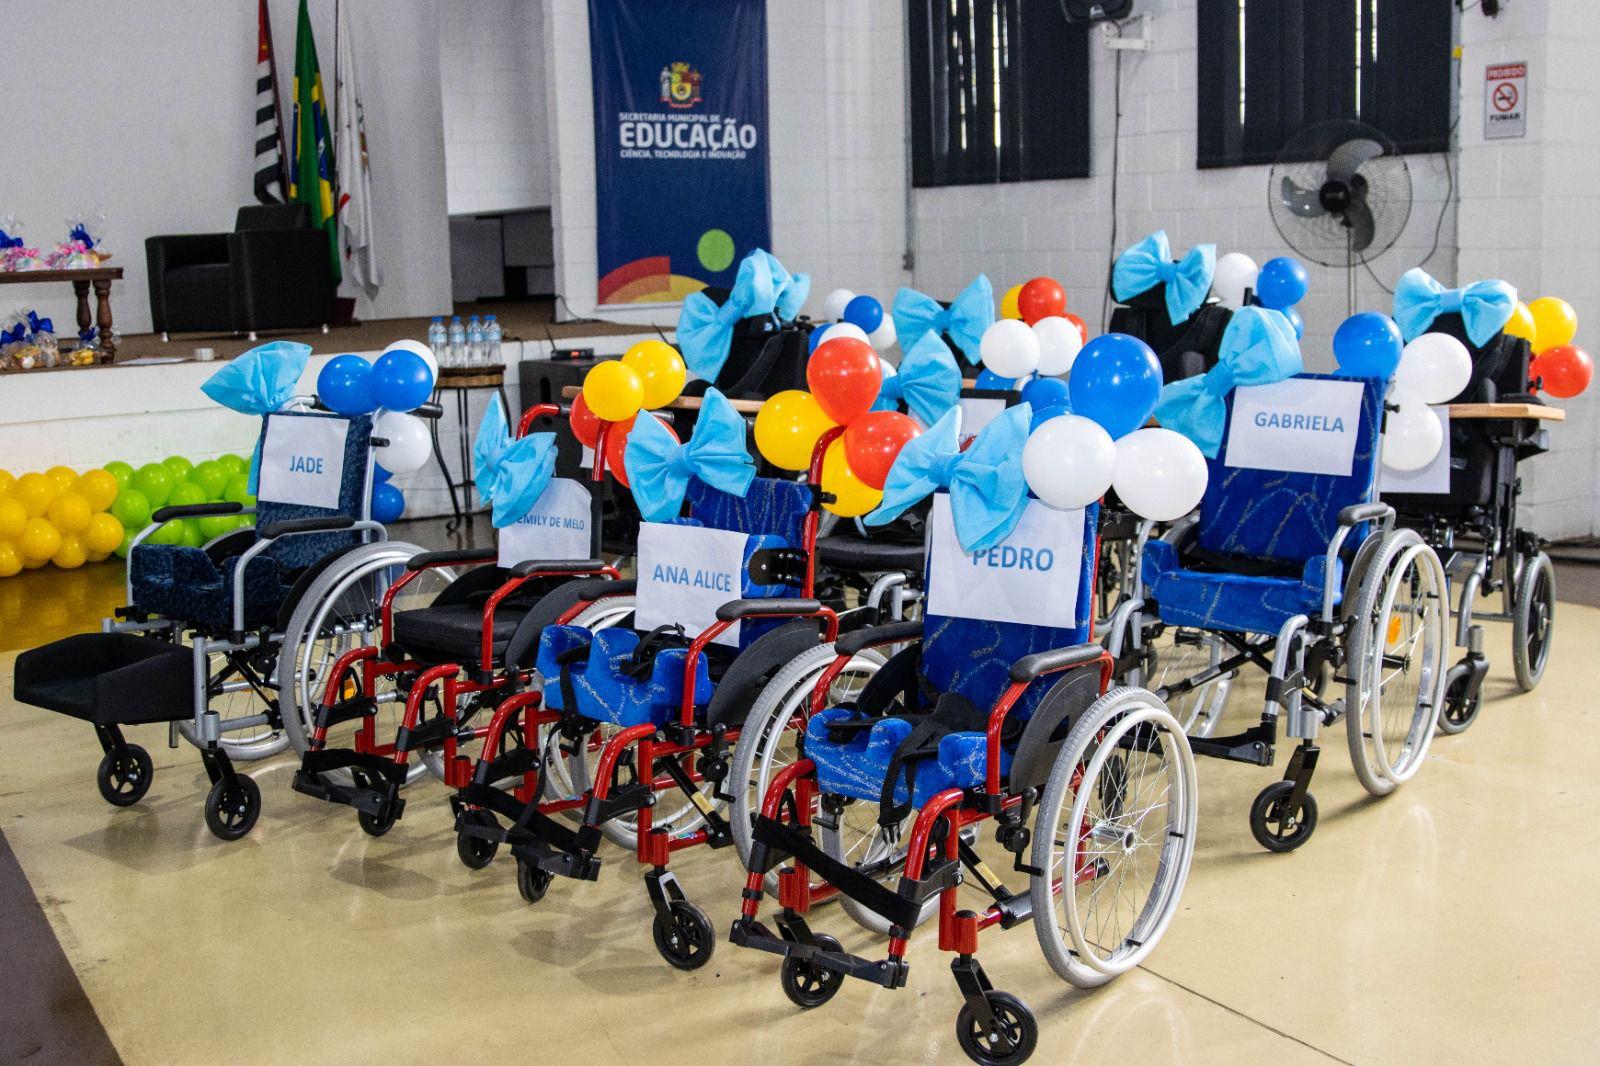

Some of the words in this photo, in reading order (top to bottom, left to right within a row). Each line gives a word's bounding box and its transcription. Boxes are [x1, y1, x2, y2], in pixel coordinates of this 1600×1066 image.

[619, 112, 666, 121] SECRETARIA
[667, 114, 708, 123] MUNICIPAL
[710, 114, 720, 122] DE
[620, 118, 757, 151] EDUCAÇÃO
[620, 148, 653, 159] CIÊNCIA,
[654, 149, 700, 159] TECNOLOGIA
[709, 149, 747, 160] INOVAÇÃO
[1254, 412, 1345, 433] GABRIELA
[289, 455, 324, 474] JADE
[549, 517, 561, 528] DE
[563, 518, 585, 530] MELO
[972, 544, 1054, 572] PEDRO
[652, 564, 689, 586] ANA
[693, 568, 731, 593] ALICE
